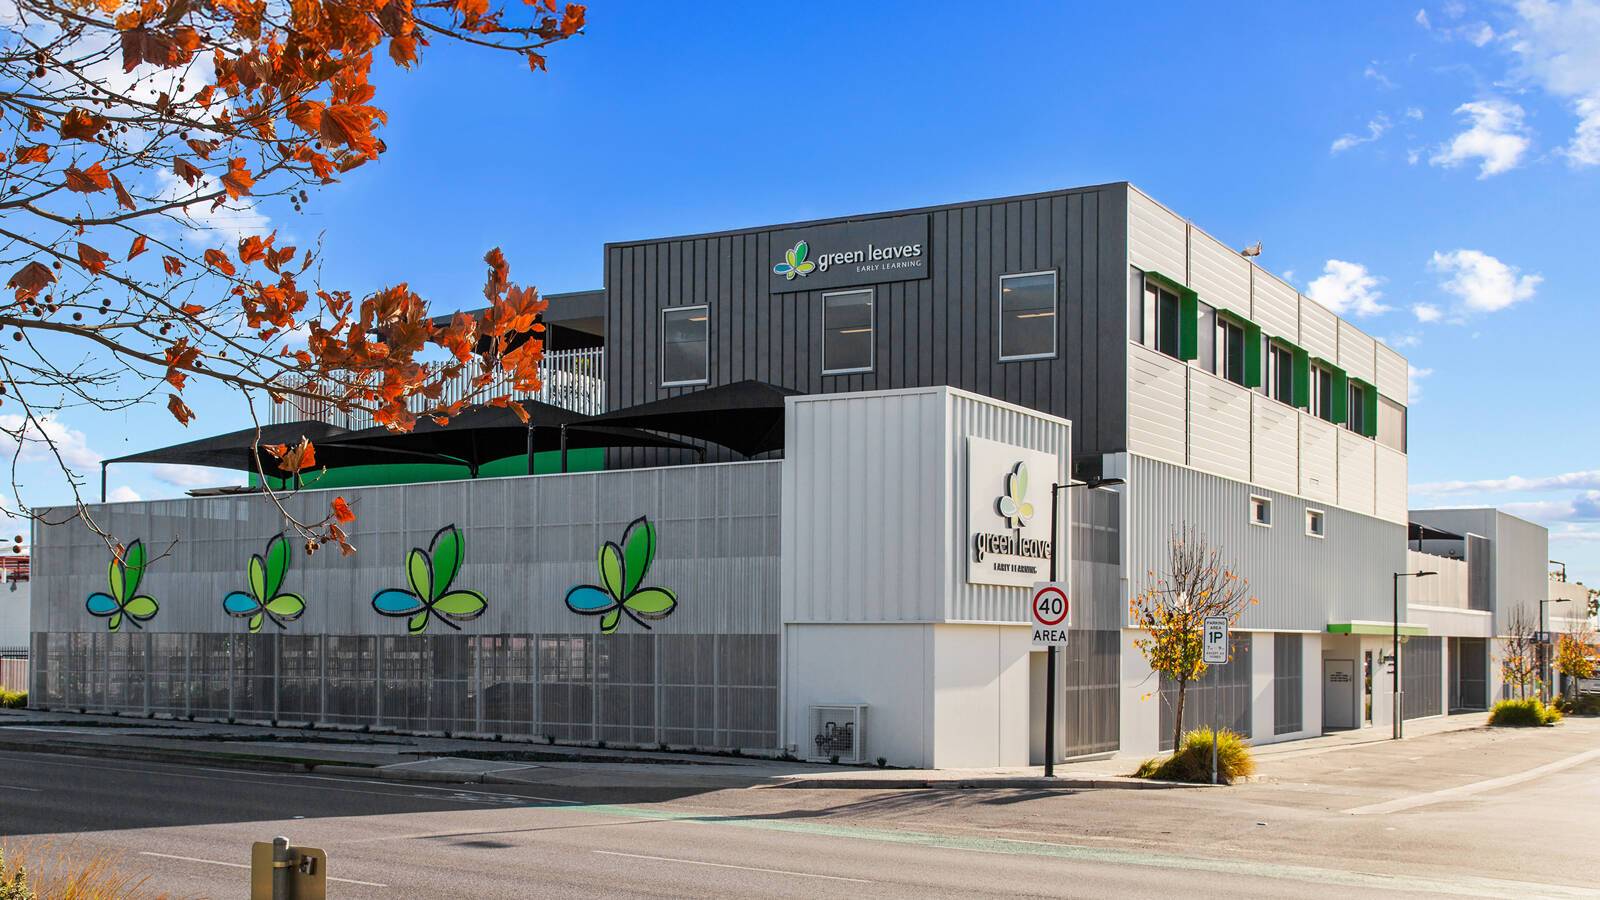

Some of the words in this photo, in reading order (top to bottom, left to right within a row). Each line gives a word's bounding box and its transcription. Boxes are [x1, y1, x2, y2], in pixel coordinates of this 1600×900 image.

[818, 249, 864, 272] green
[868, 243, 921, 261] leaves
[856, 264, 880, 273] EARLY
[882, 259, 922, 270] LEARNING
[976, 532, 1014, 563] green
[1017, 528, 1052, 560] leave
[1038, 598, 1063, 615] 40
[1033, 630, 1067, 642] AREA
[1209, 631, 1223, 643] 1P
